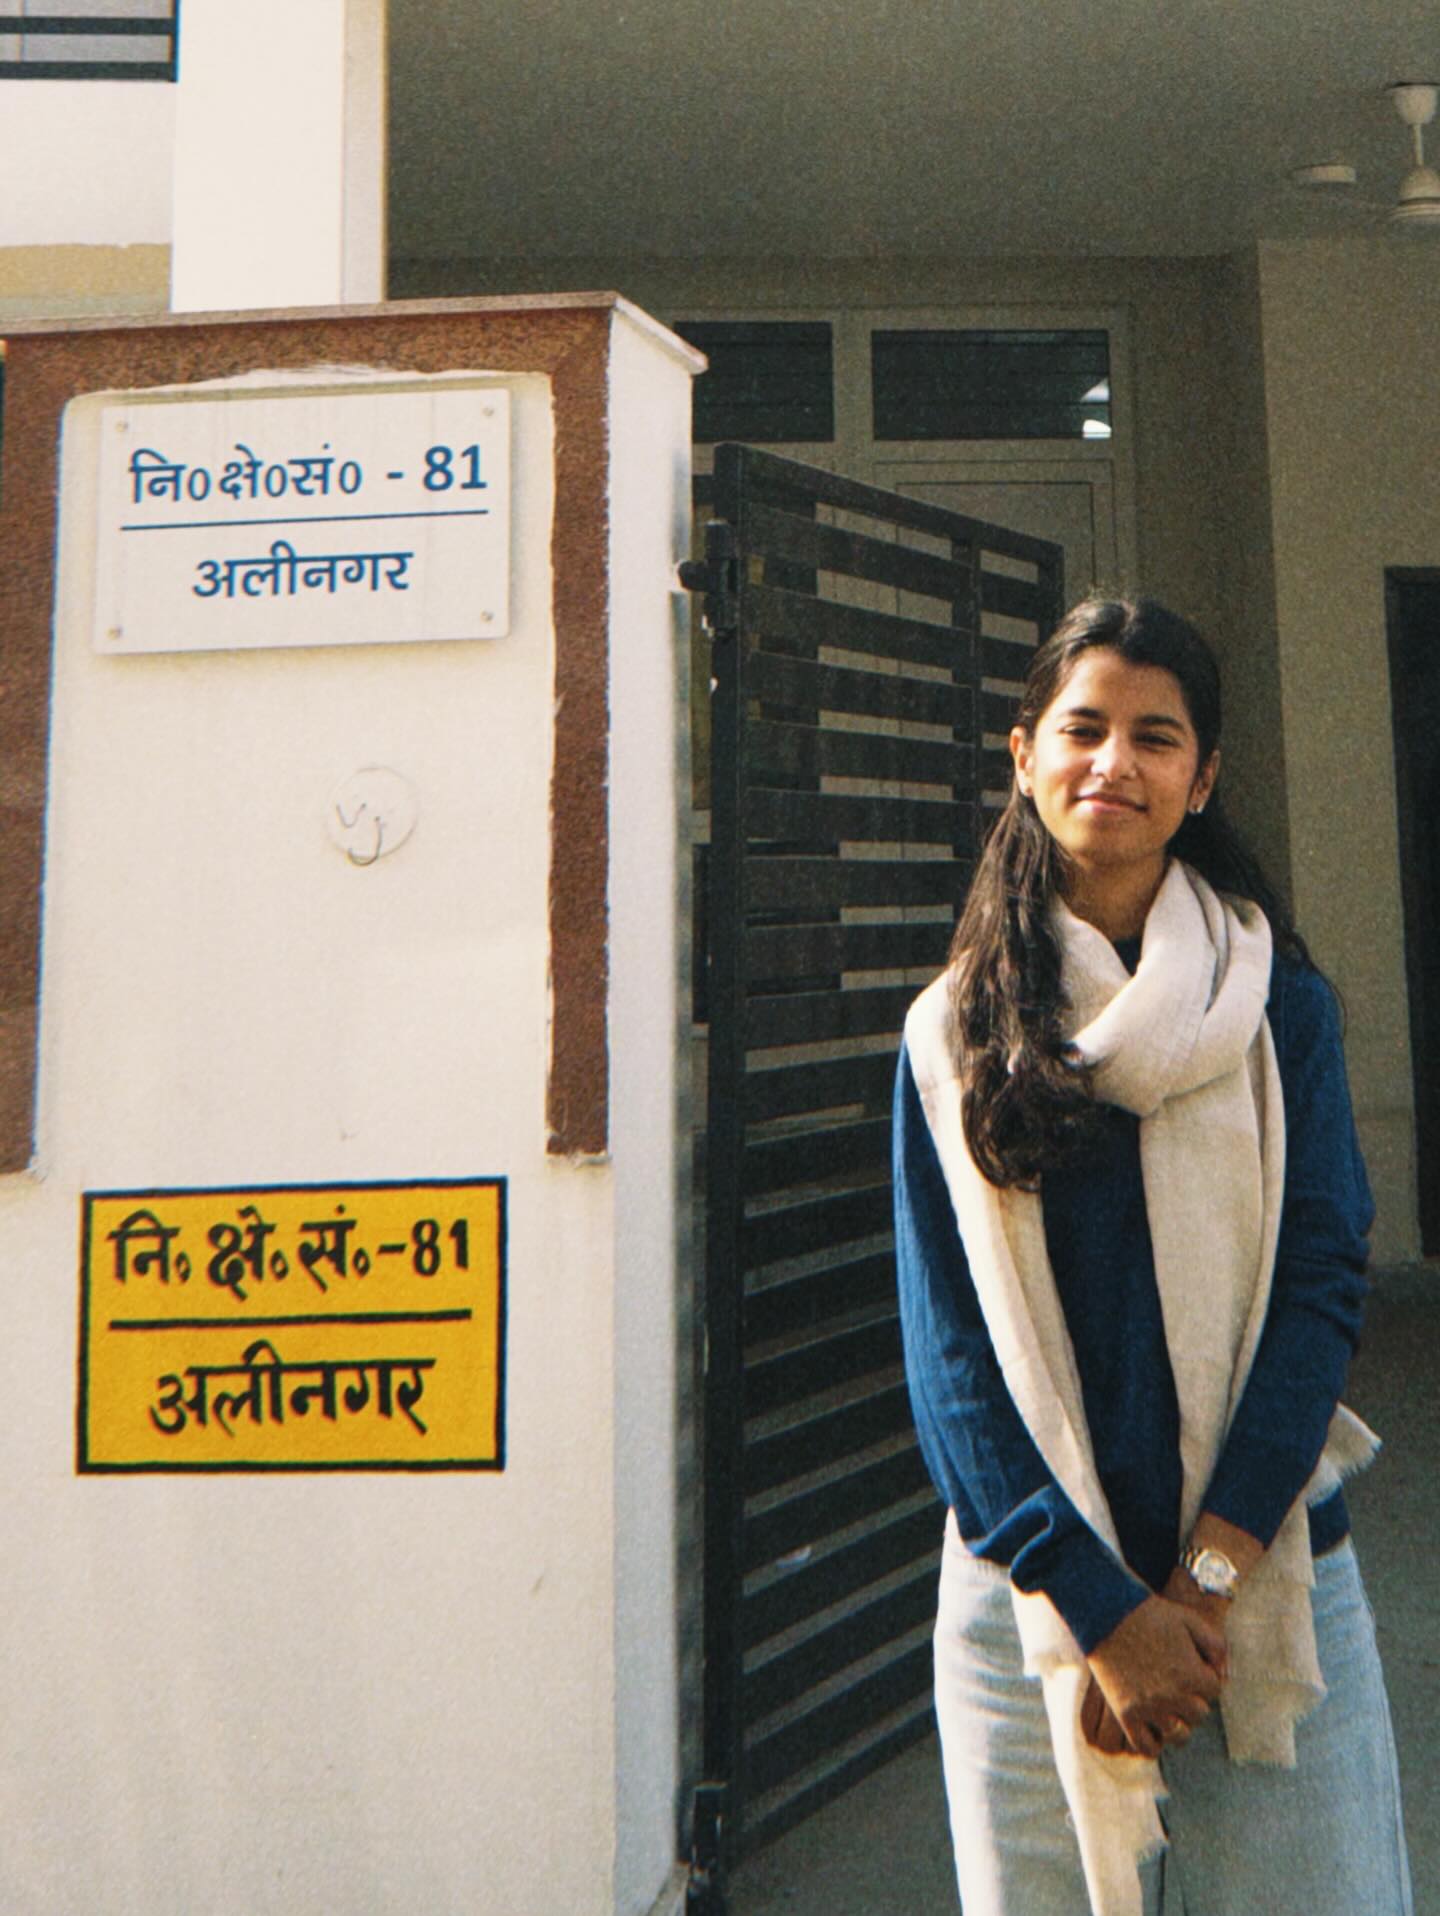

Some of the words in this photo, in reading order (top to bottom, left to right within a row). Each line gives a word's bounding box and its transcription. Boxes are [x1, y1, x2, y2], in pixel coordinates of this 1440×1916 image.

[423, 444, 488, 492] 81
[193, 539, 415, 598] अलीनगर
[149, 1339, 437, 1435] अलीनगर
